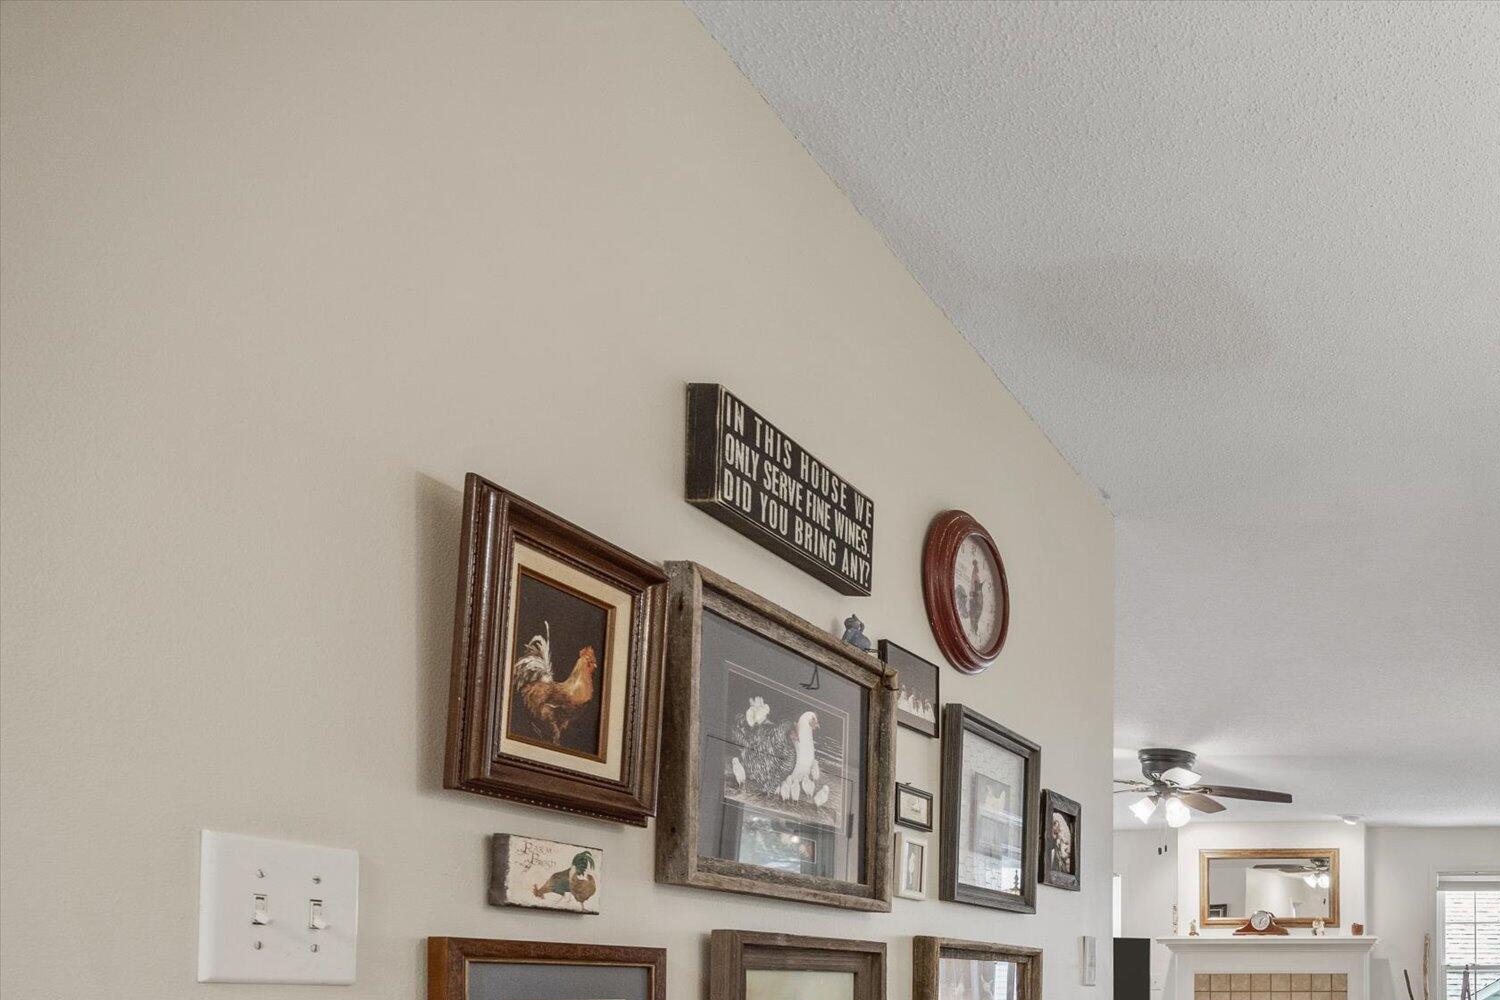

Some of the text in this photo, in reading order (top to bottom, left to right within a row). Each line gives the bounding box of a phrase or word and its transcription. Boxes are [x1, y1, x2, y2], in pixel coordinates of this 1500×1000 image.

[725, 433, 870, 558] ONLY SERVE FINE WINES.
[726, 396, 872, 529] IN THIS HOUSE WE
[724, 468, 870, 588] DID YOU BRING ANY?
